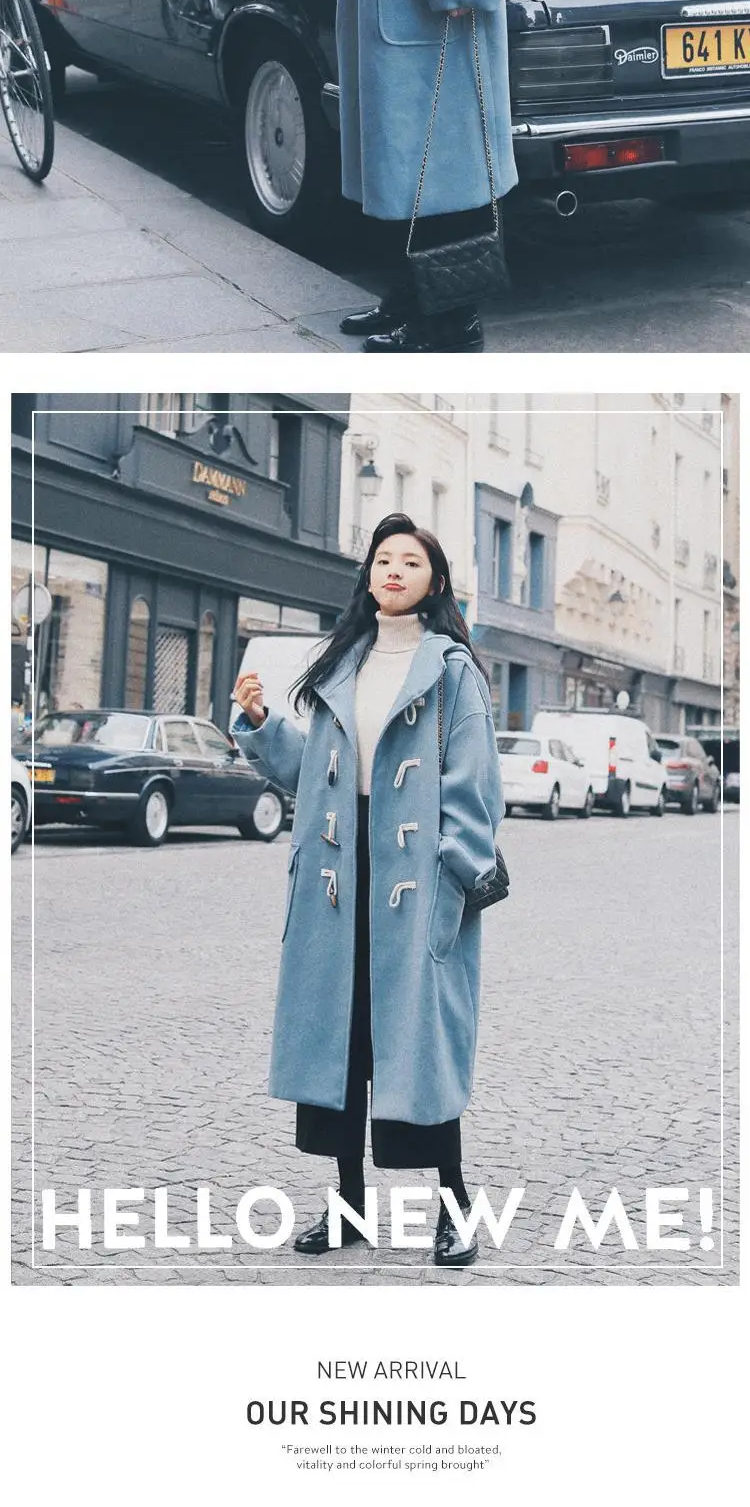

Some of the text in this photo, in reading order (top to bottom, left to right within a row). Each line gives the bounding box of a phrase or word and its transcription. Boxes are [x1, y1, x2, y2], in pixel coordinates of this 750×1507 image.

[614, 46, 659, 65] Daimler
[682, 28, 750, 63] 641 K
